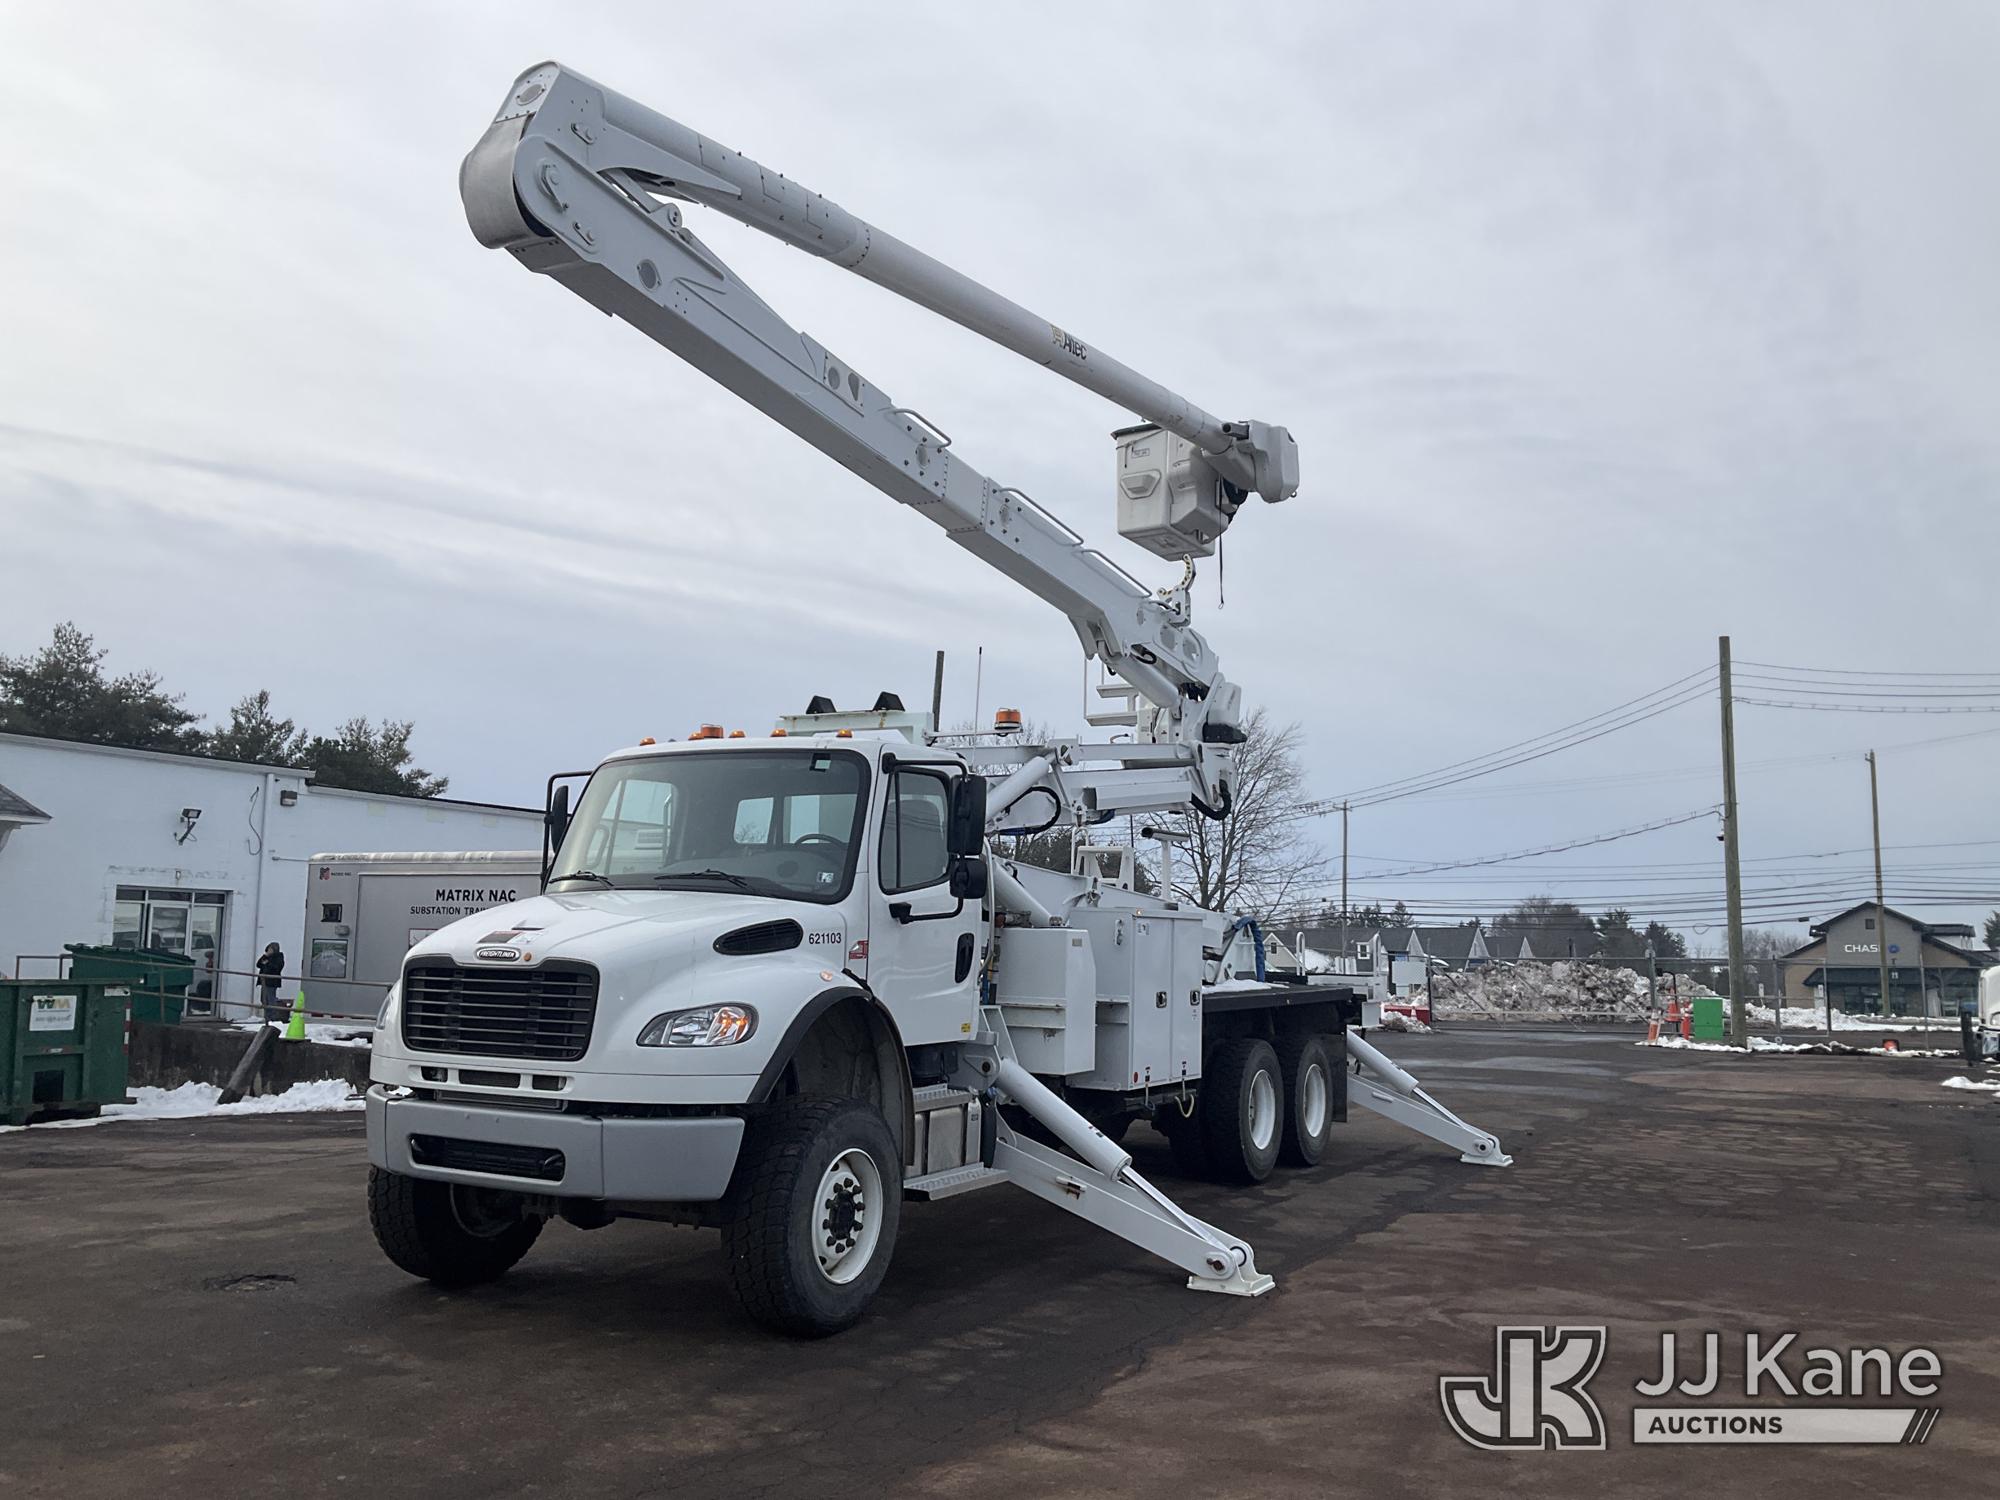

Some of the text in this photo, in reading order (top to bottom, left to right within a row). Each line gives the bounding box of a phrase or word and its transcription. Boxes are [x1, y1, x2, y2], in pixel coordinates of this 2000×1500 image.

[436, 889, 516, 902] MATRIX NAC
[410, 906, 460, 915] SUBSTATION
[809, 932, 842, 944] 621103
[1844, 944, 1880, 953] CHAS
[480, 950, 515, 958] FREIGHTLINER
